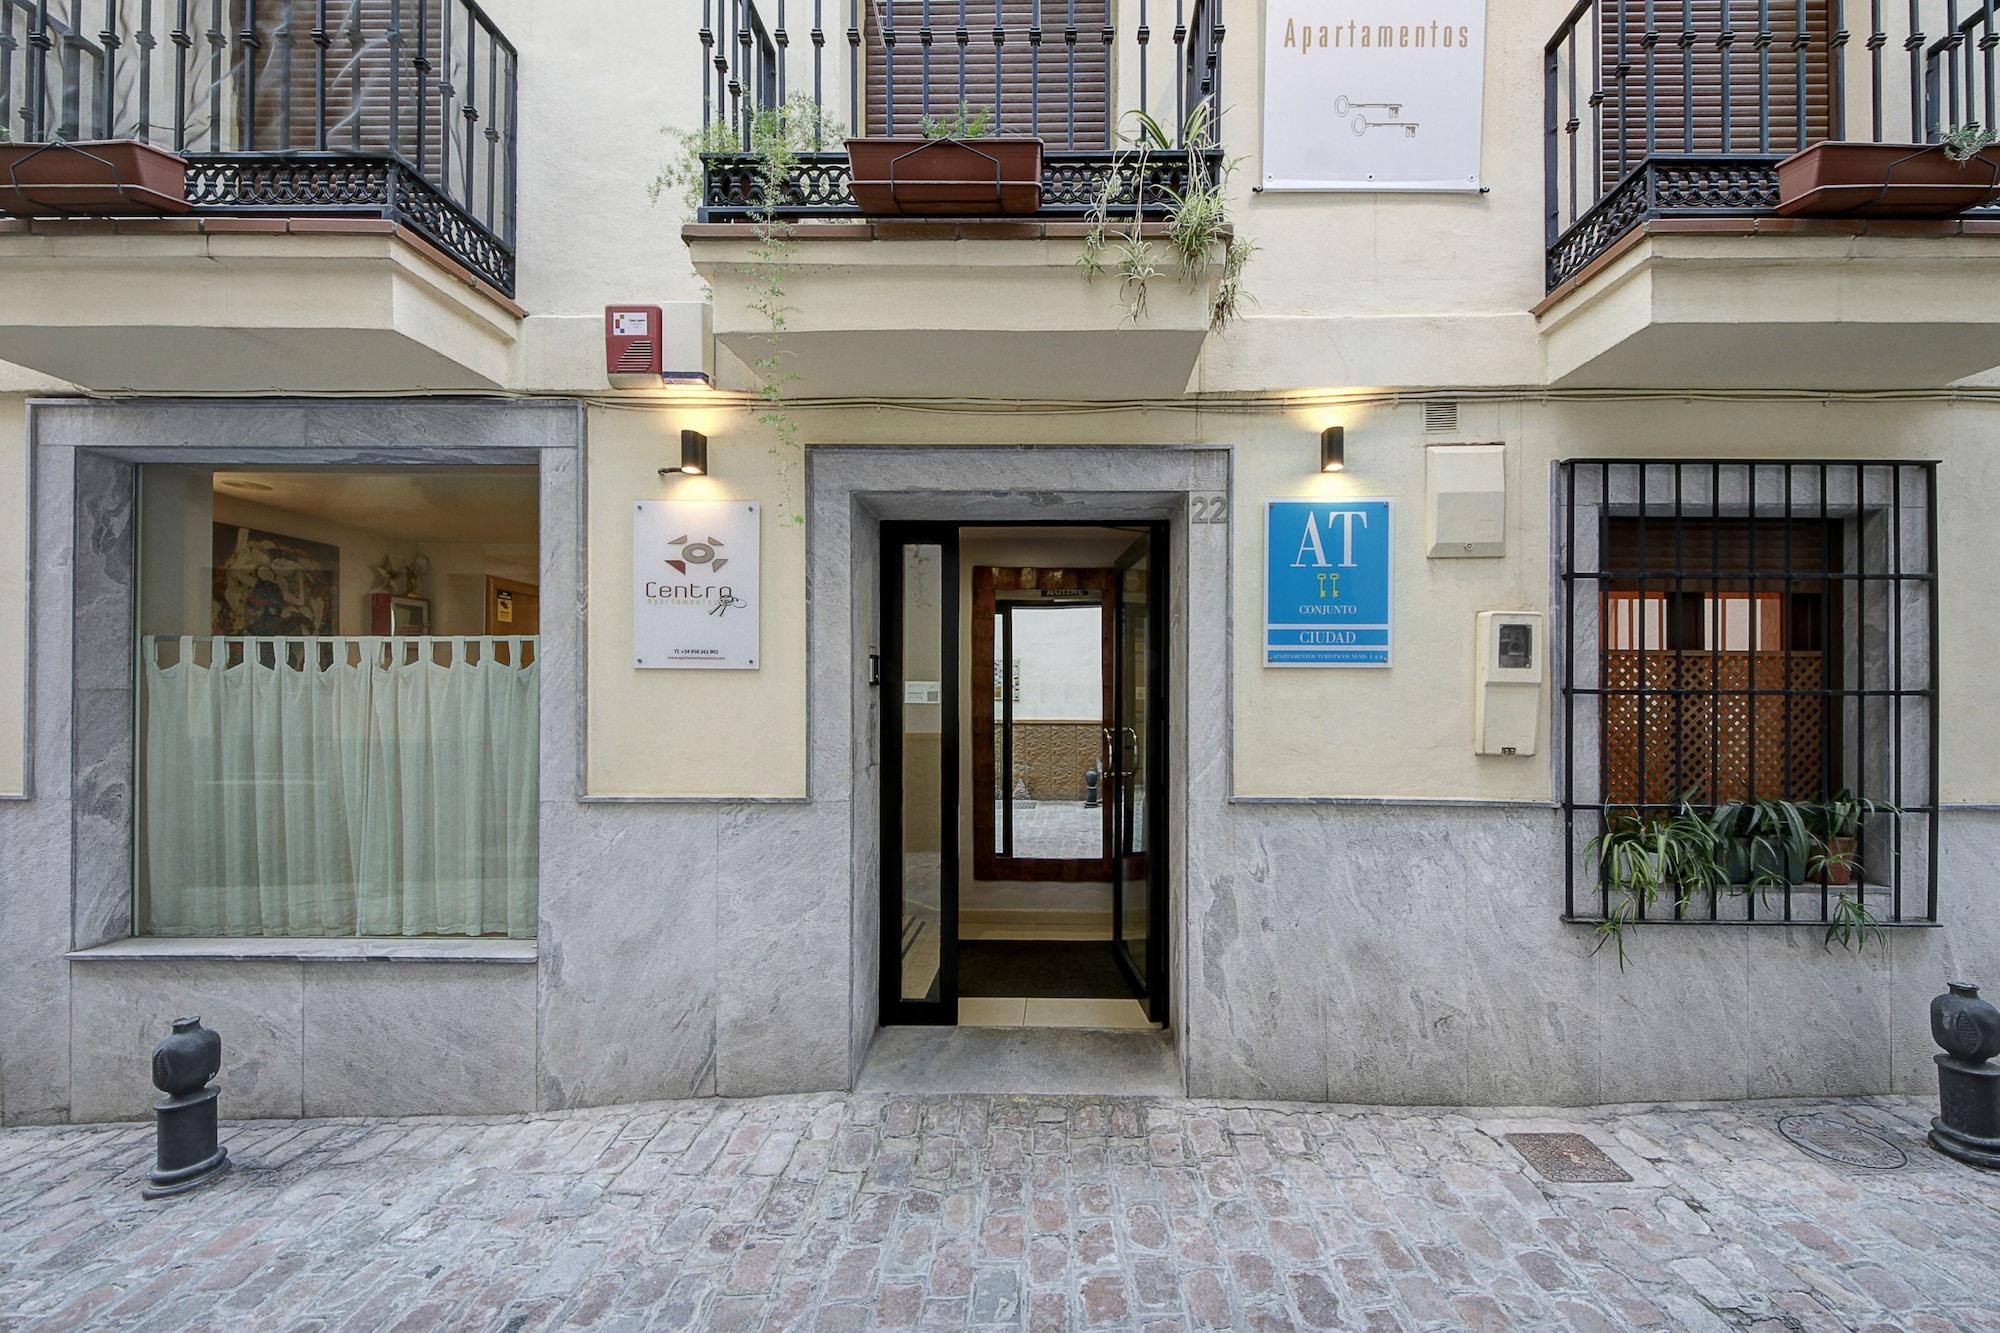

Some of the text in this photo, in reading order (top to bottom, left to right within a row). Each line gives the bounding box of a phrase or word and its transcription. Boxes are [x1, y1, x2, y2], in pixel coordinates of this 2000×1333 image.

[1284, 17, 1469, 55] Apartamentos
[1191, 496, 1227, 524] 22
[1290, 511, 1368, 567] AT
[646, 581, 732, 599] Centro
[1299, 604, 1357, 615] CONJUNTO
[1299, 631, 1357, 644] CIUDAD
